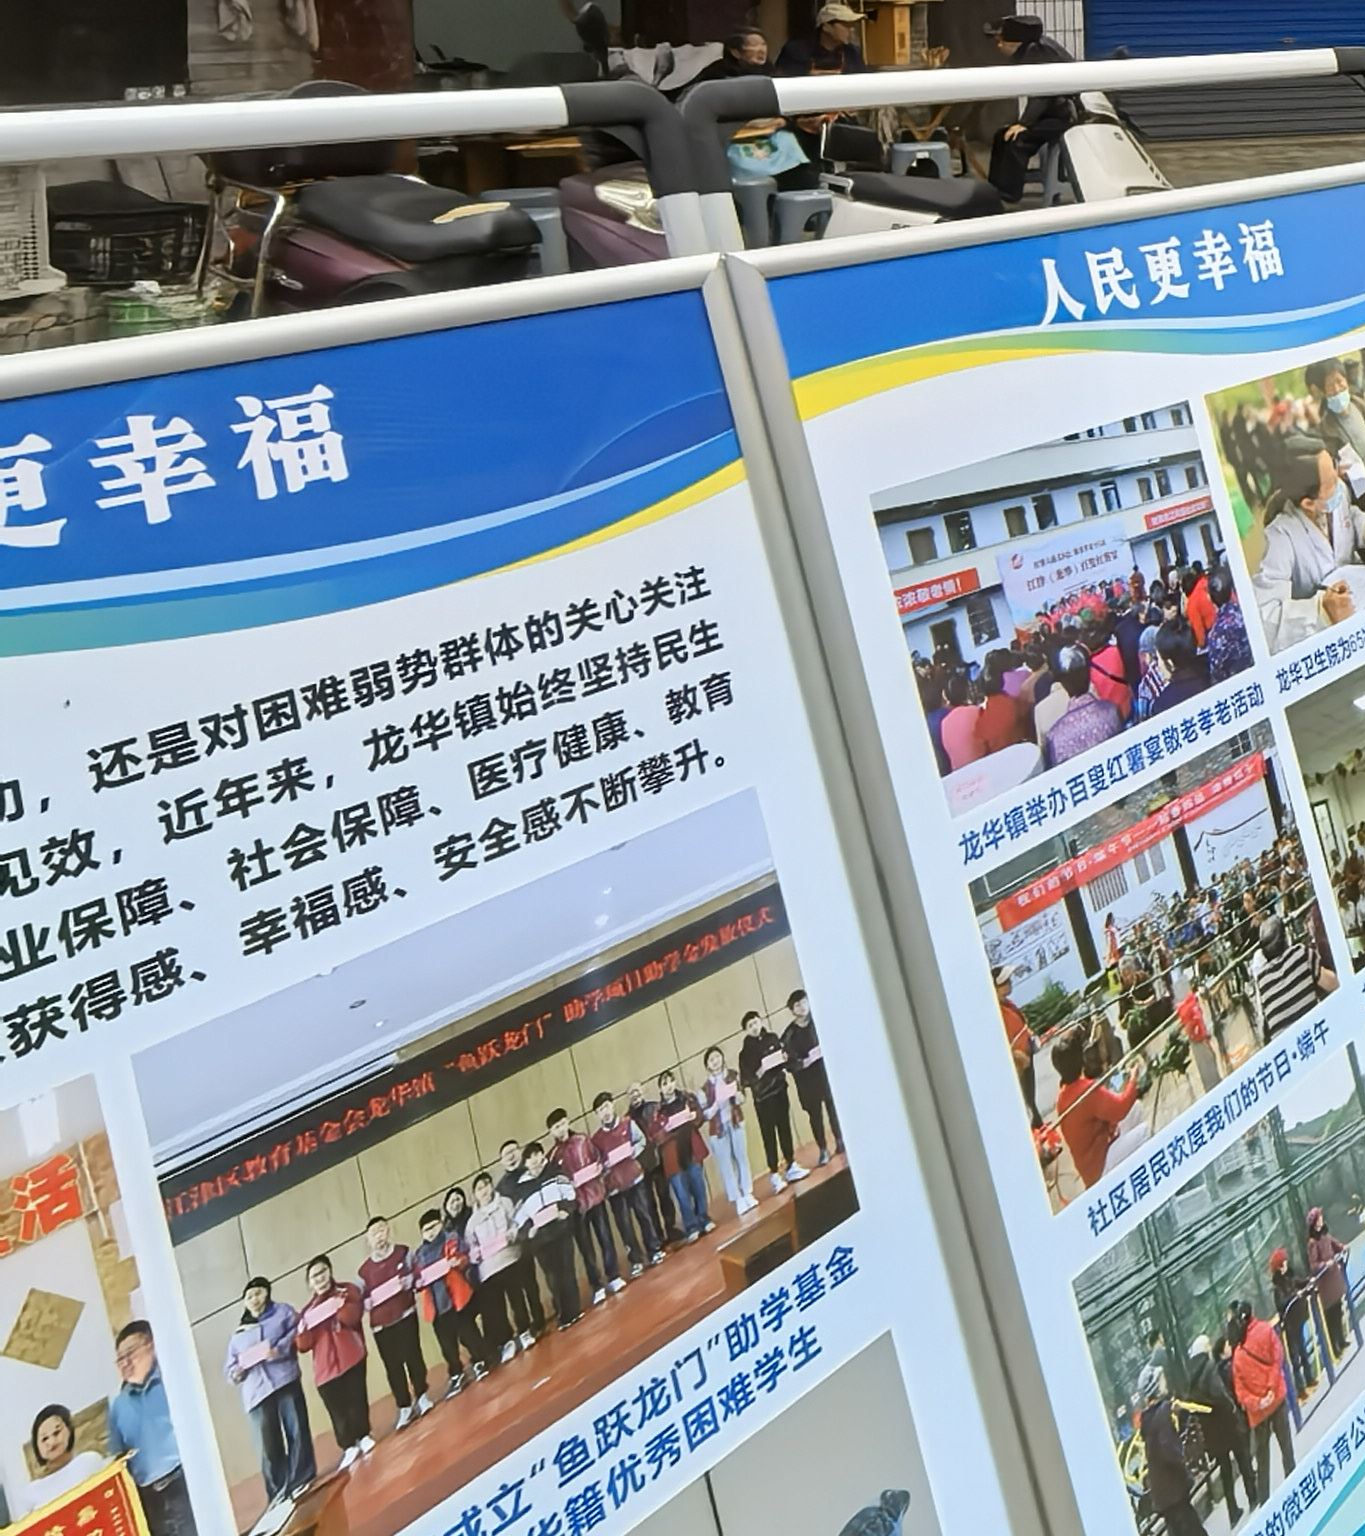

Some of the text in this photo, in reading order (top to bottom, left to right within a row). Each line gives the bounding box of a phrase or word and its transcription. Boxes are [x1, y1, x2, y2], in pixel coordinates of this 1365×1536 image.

[1039, 219, 1286, 326] 人民更幸福
[957, 681, 1265, 866] 龙华镇举办百叟红薯宴敬老孝老活动
[1086, 1018, 1331, 1238] 社区居民欢度我们的节日·端午
